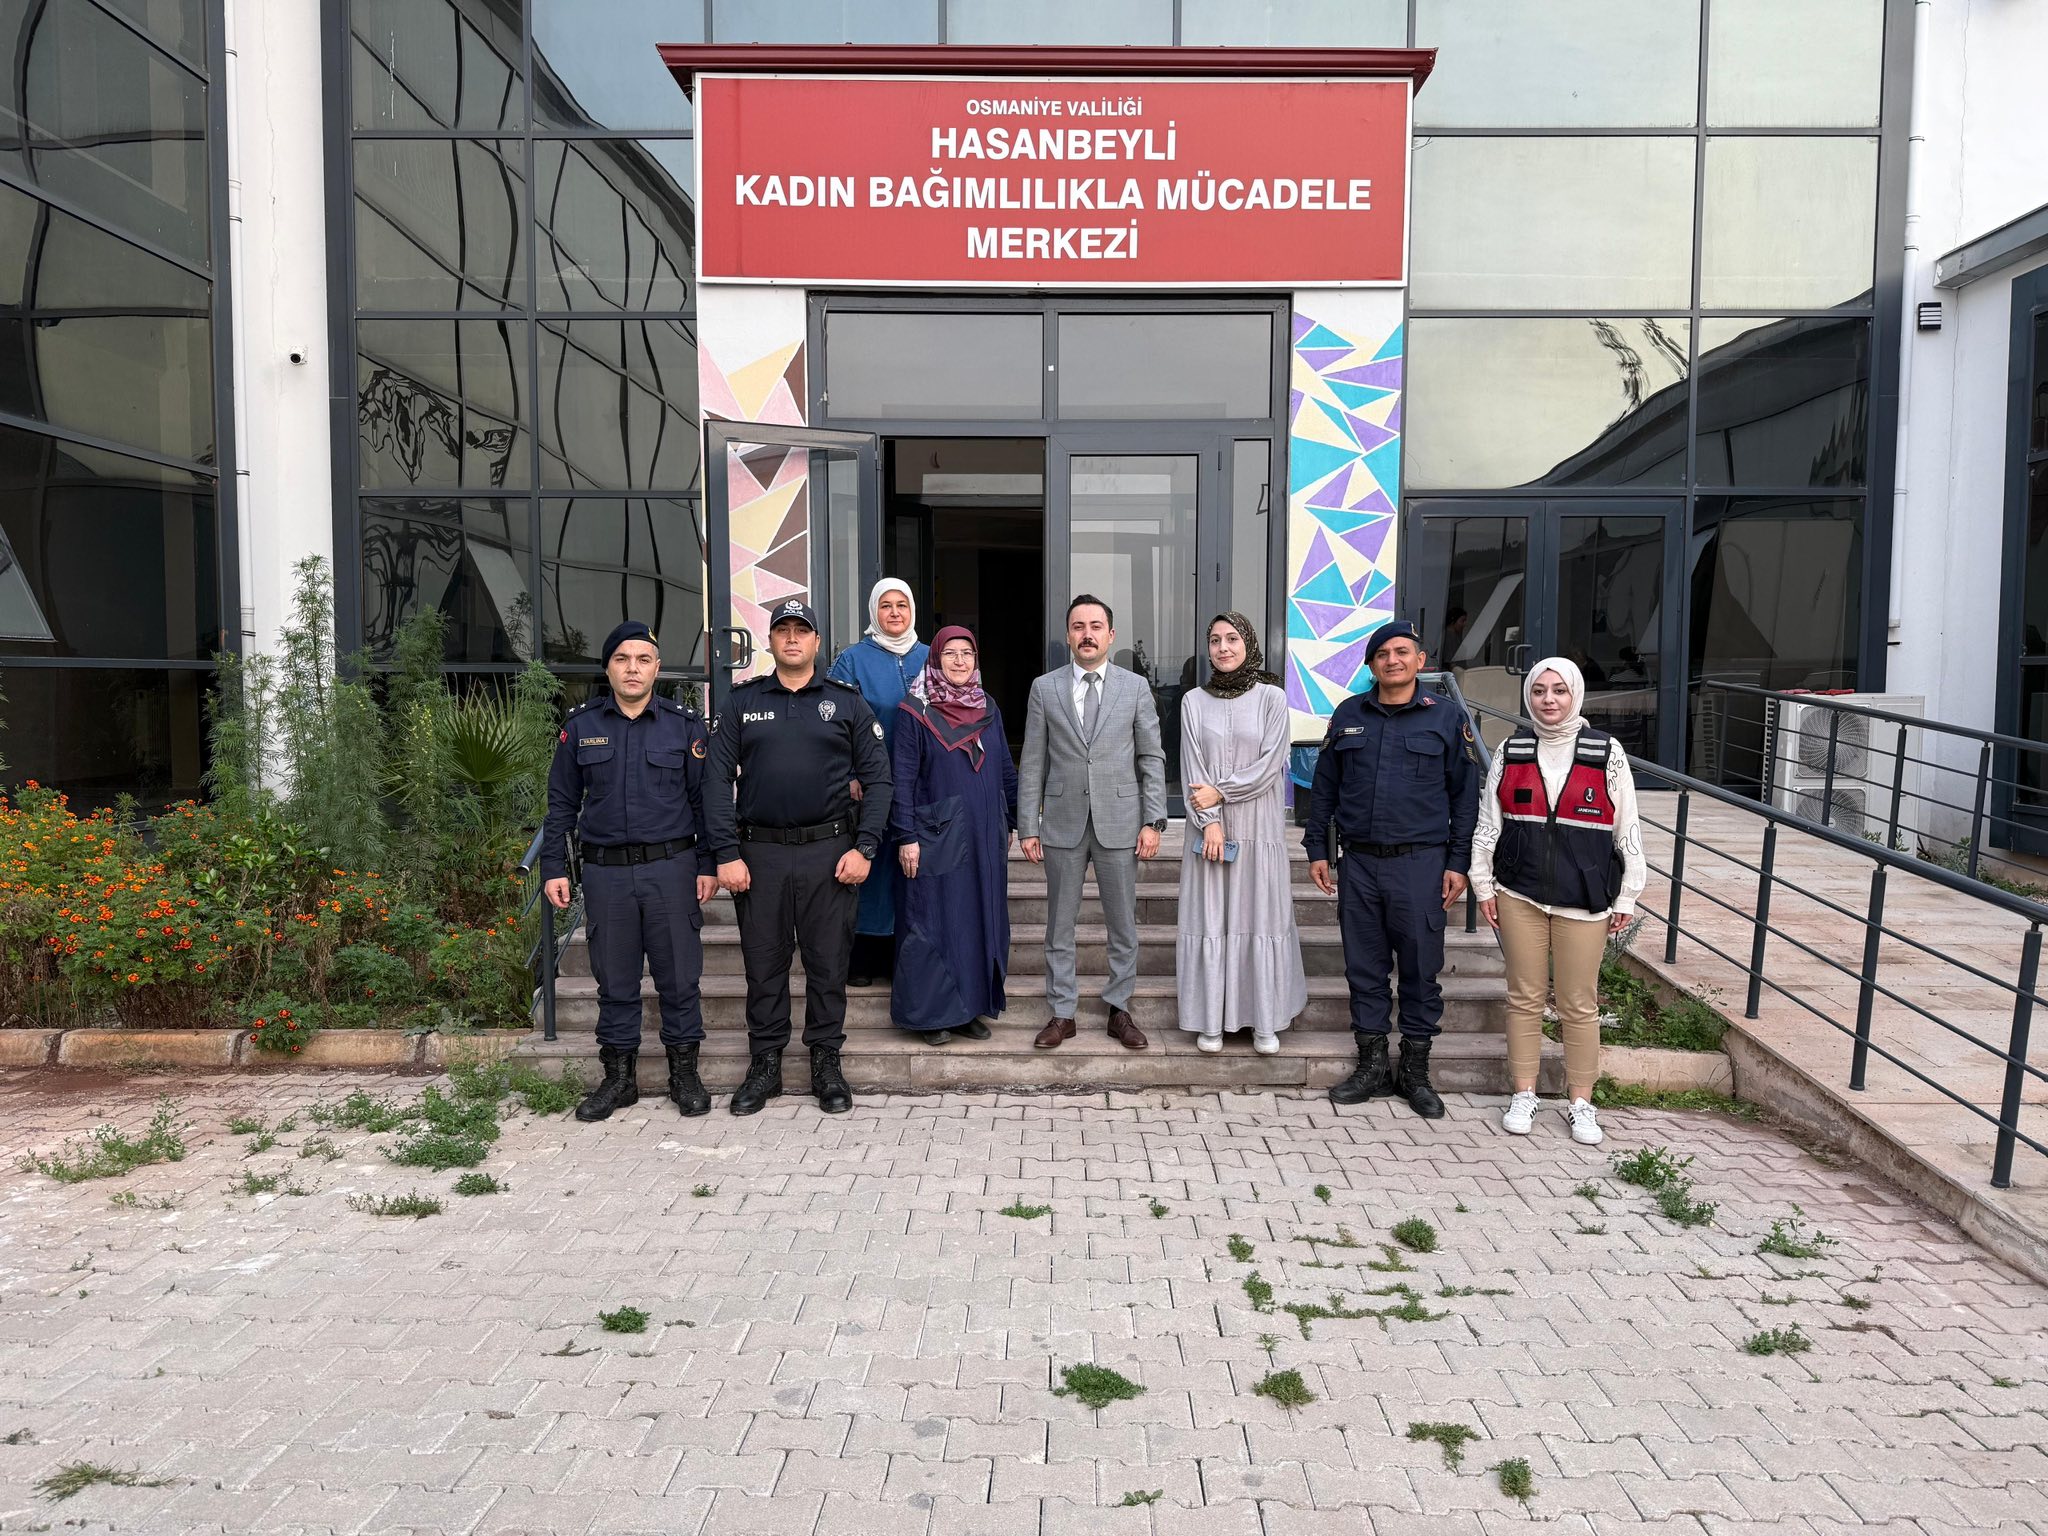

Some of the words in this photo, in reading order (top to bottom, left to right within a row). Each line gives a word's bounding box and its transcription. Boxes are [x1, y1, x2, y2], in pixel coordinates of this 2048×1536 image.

[966, 97, 1063, 117] OSMANİYE
[1066, 96, 1144, 117] VALİLİĞİ
[931, 120, 1178, 161] HASANBEYLİ
[735, 174, 856, 209] KADIN
[868, 167, 1146, 211] BAĞIMLILIKLA
[1156, 169, 1373, 212] MÜCADELE
[967, 218, 1139, 260] MERKEZİ
